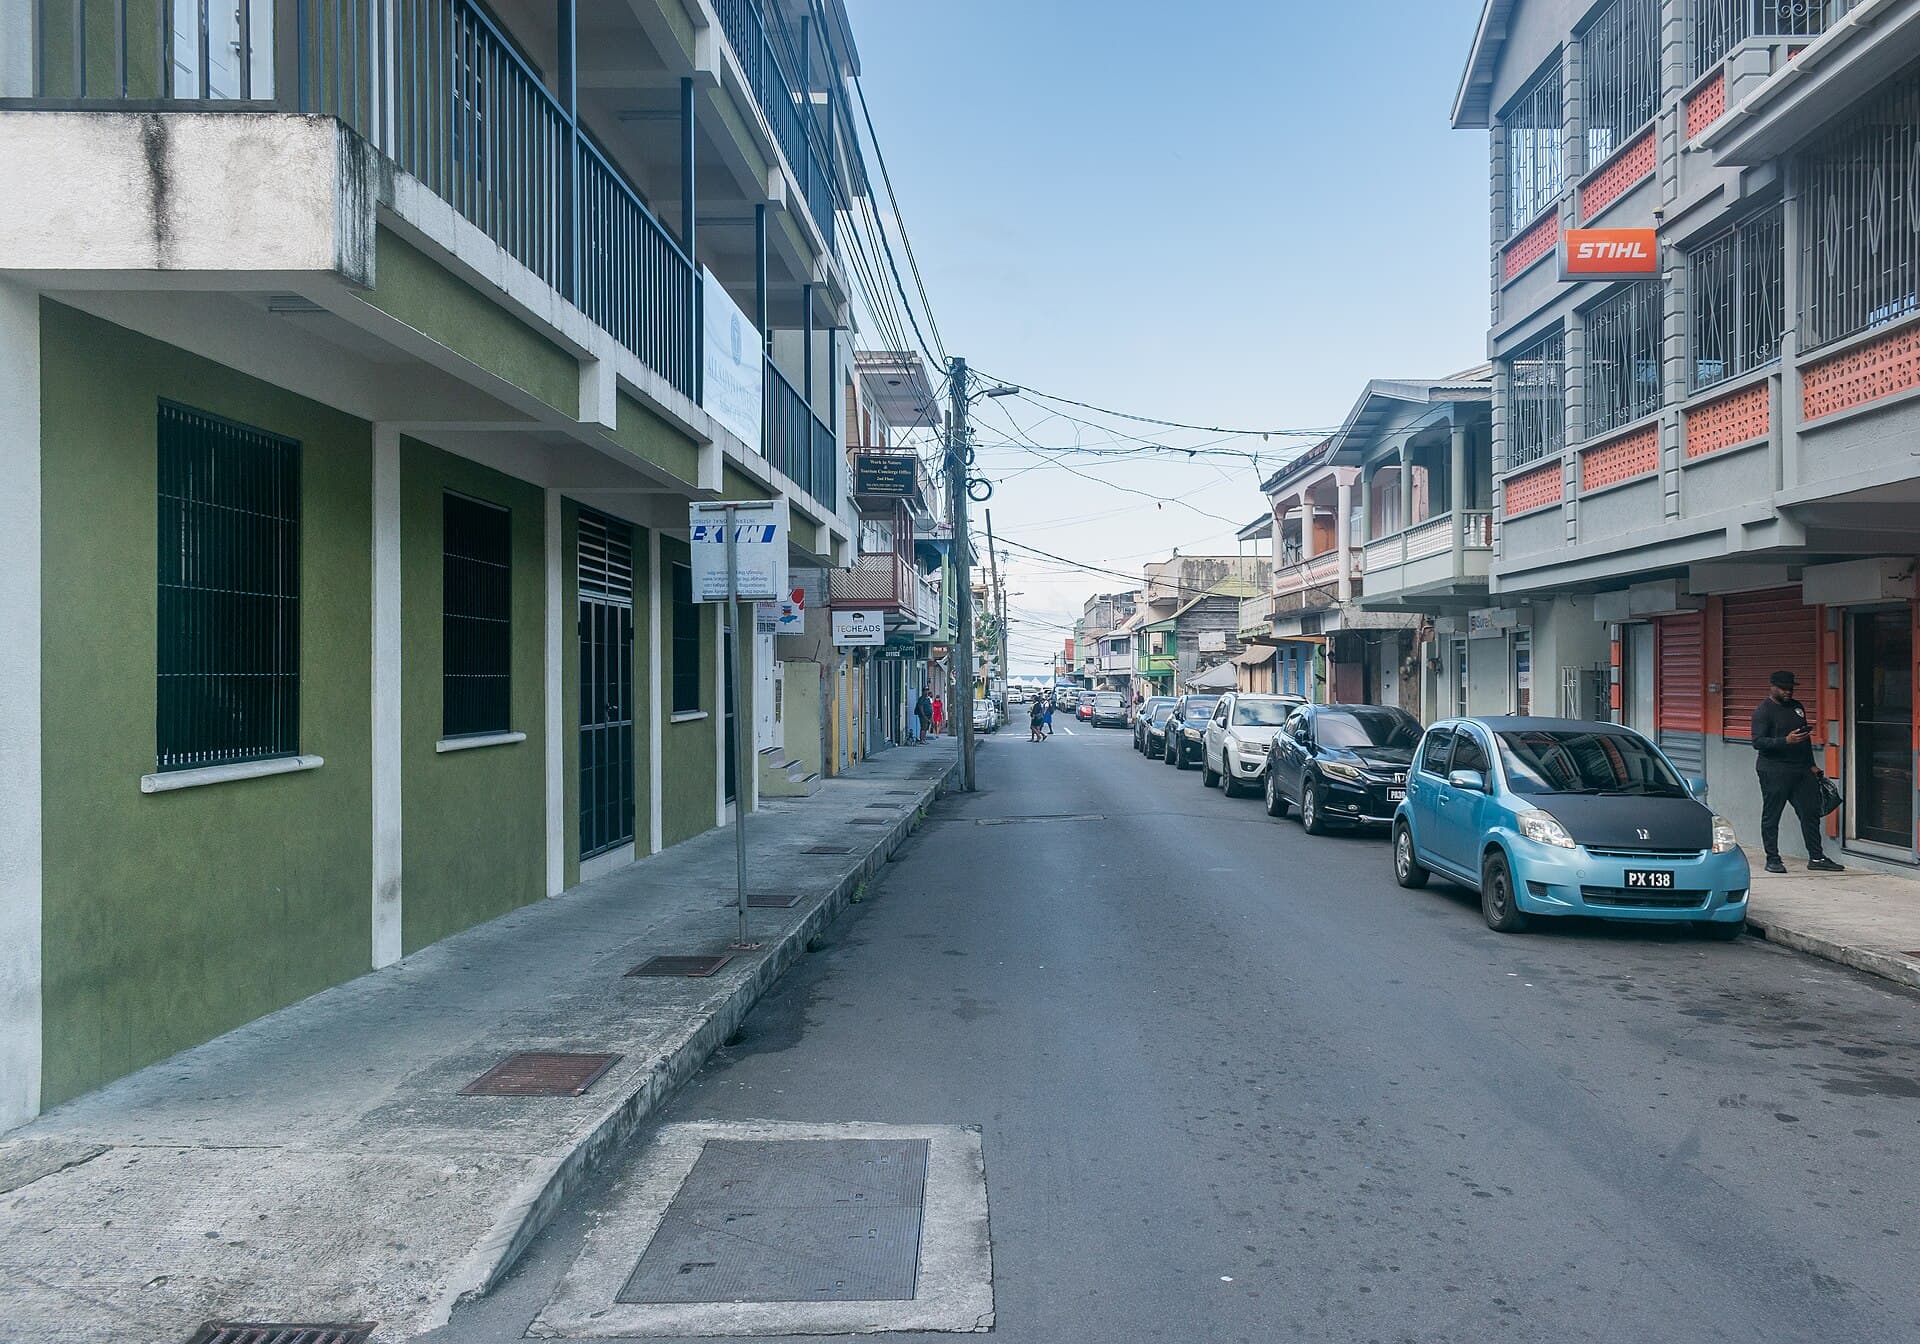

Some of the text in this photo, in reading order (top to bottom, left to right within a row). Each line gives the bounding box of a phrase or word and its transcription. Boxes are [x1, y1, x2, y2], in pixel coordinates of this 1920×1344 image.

[1577, 242, 1647, 259] STIHL
[836, 625, 881, 633] TECHEADS
[1628, 872, 1670, 887] PX 138
